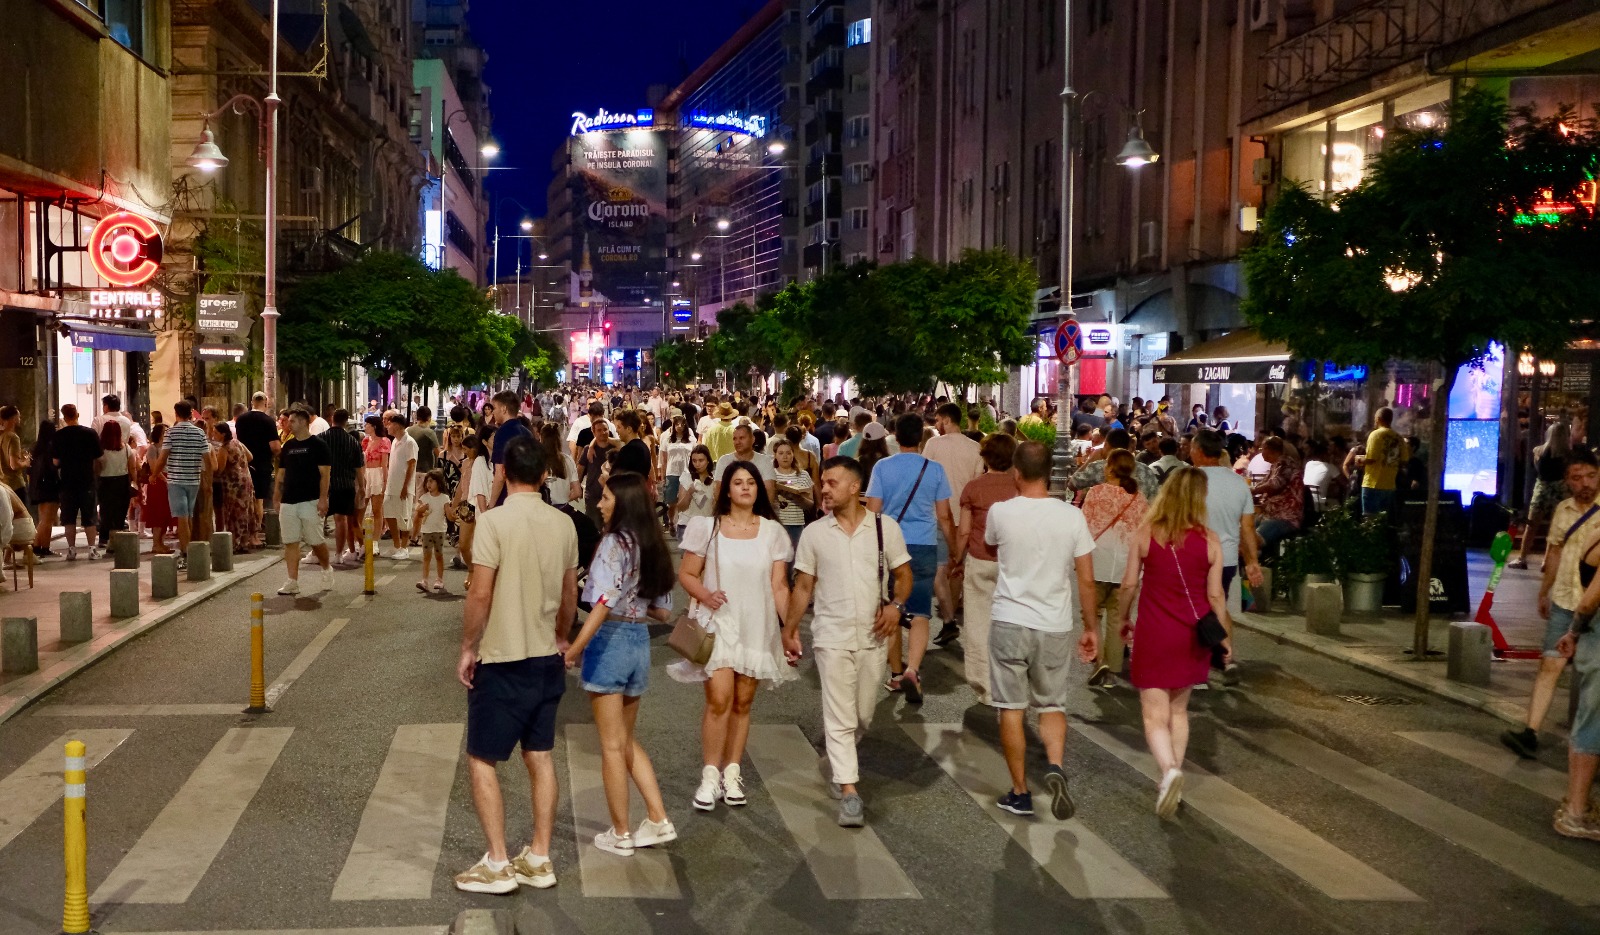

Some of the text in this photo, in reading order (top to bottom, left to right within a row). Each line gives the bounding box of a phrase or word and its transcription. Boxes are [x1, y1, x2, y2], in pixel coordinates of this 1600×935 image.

[571, 108, 636, 136] Radisson
[617, 149, 655, 158] PARADISUL
[587, 160, 652, 170] PE INSULA CORONA!
[588, 201, 648, 223] Corona
[633, 245, 641, 253] PE
[90, 291, 161, 305] CENTRALE
[20, 357, 34, 366] 122
[1204, 366, 1230, 380] ZAGANU
[1465, 437, 1480, 449] DA
